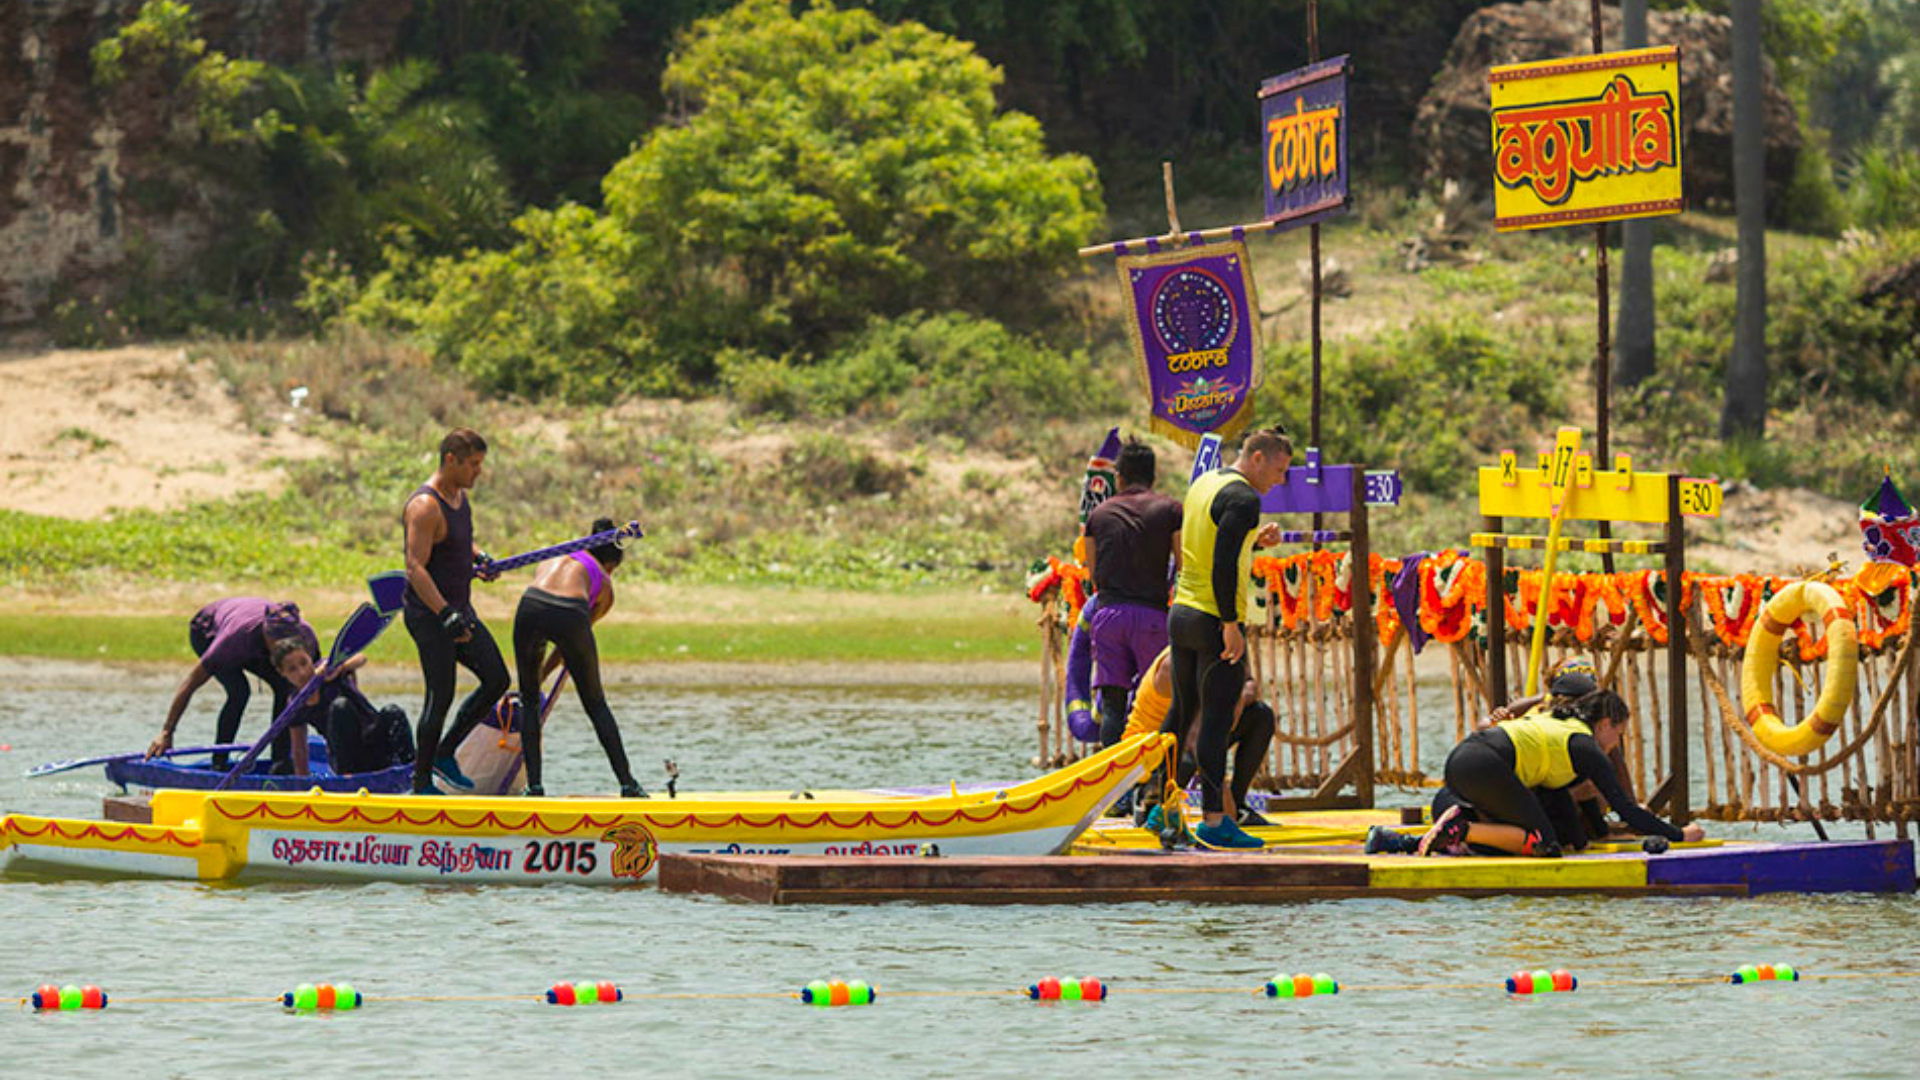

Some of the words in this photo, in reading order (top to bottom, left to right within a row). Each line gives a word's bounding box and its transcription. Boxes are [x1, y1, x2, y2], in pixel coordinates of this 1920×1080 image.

[1267, 96, 1339, 190] cobra
[1494, 79, 1673, 202] aguila
[1167, 348, 1228, 373] cobra
[523, 840, 597, 875] 2015
